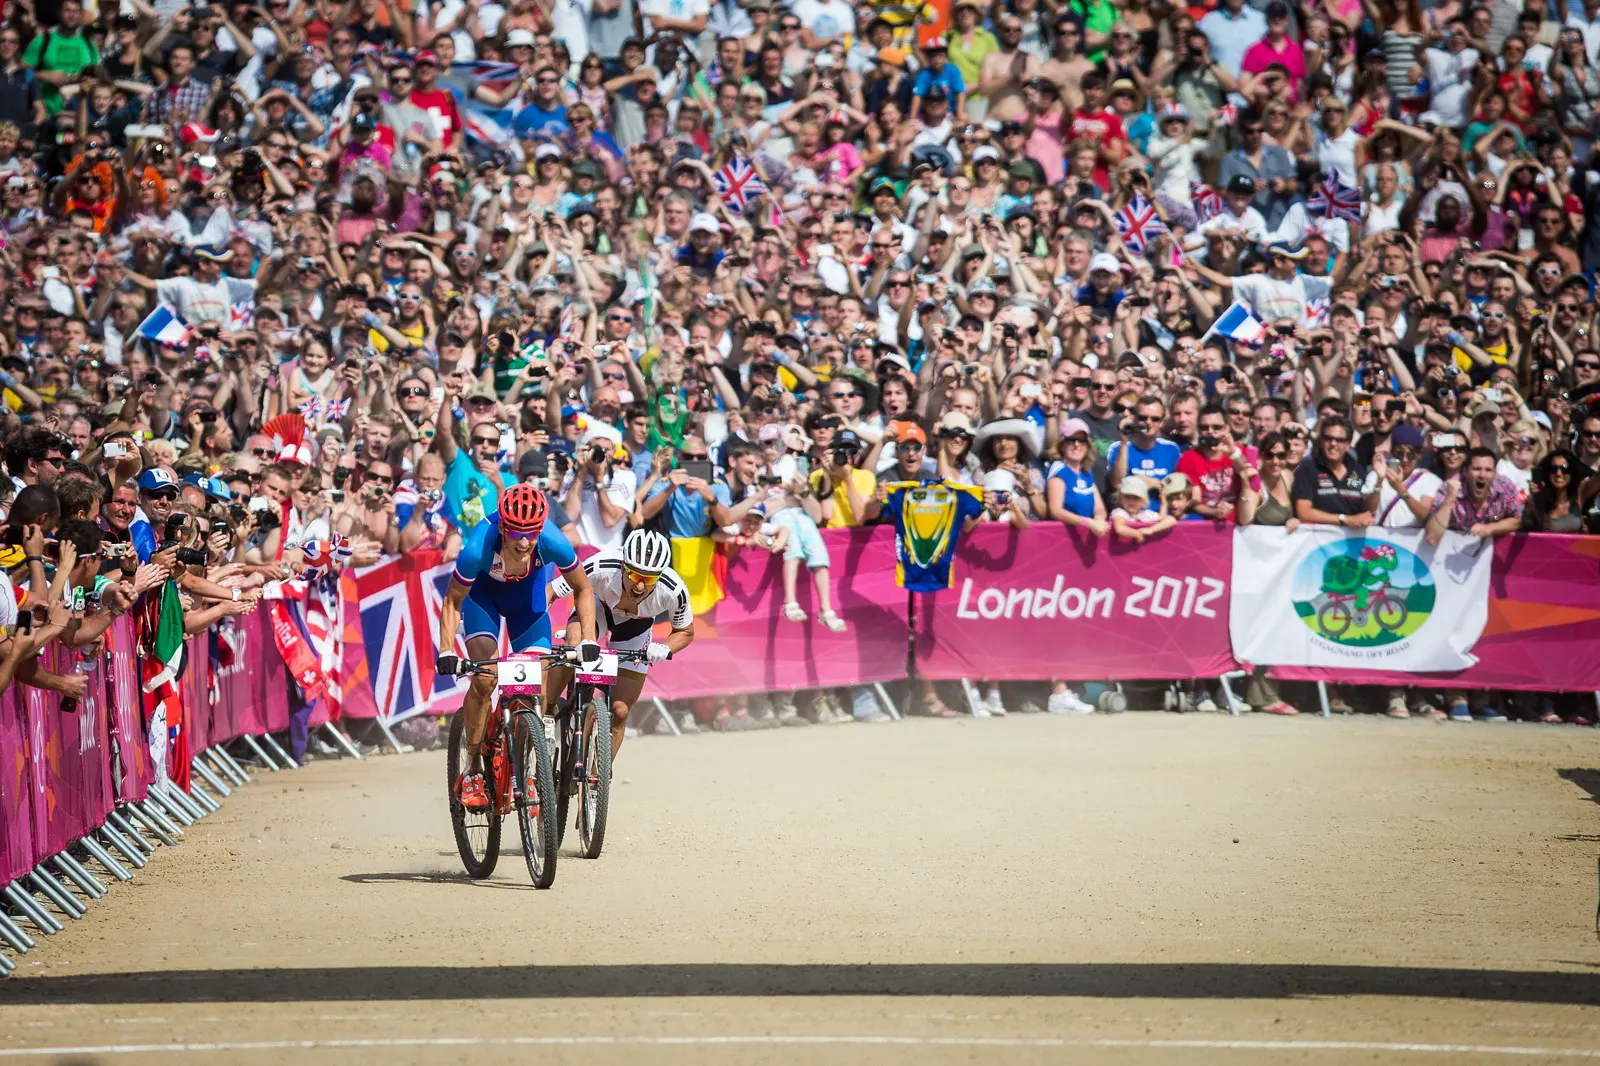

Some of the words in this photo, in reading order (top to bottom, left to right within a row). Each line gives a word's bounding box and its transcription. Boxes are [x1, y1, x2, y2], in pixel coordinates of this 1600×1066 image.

[956, 573, 1116, 620] London
[1123, 575, 1226, 619] 2012
[1386, 640, 1411, 657] ROAD
[513, 662, 527, 683] 3
[591, 655, 604, 673] 2
